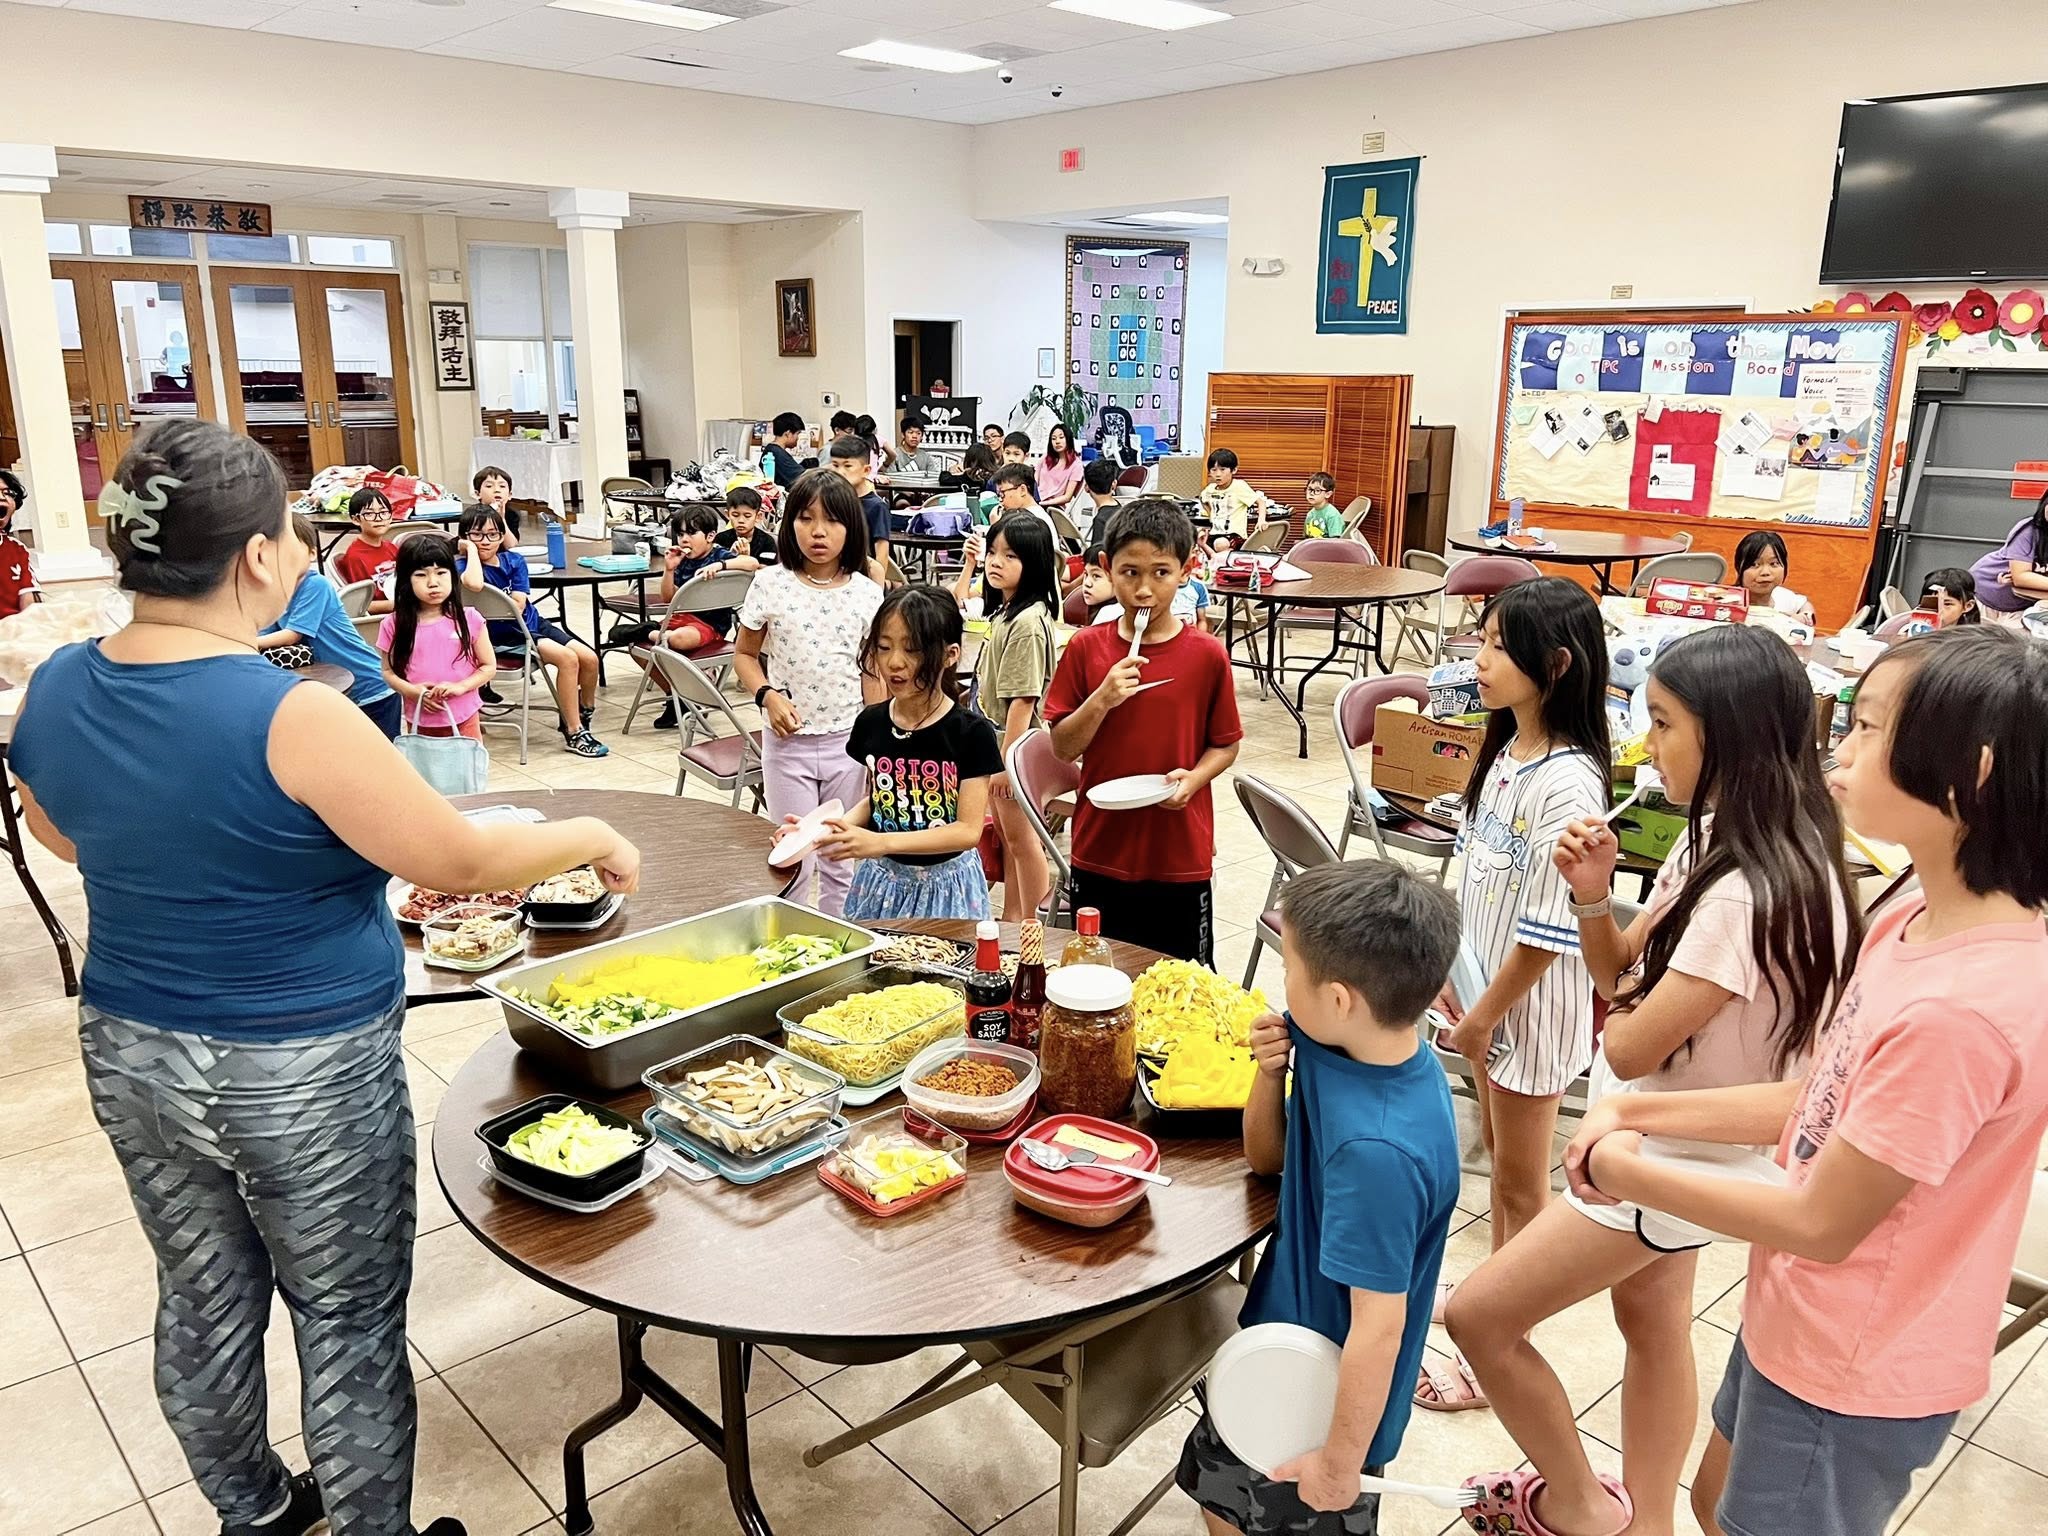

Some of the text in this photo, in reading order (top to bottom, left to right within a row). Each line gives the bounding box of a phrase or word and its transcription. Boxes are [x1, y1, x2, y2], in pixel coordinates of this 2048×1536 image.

[1367, 299, 1398, 315] PEACE
[437, 309, 468, 382] 敬拜活主
[1546, 337, 1595, 361] God
[1664, 340, 1697, 357] on
[1725, 335, 1769, 358] the
[1789, 335, 1855, 360] Move
[1652, 359, 1715, 373] Mission
[1803, 375, 1839, 384] Formosa's
[1804, 386, 1824, 395] Voice
[1408, 721, 1447, 738] Artisan
[977, 1027, 1007, 1039] SAUCE
[983, 1022, 1002, 1032] SOY
